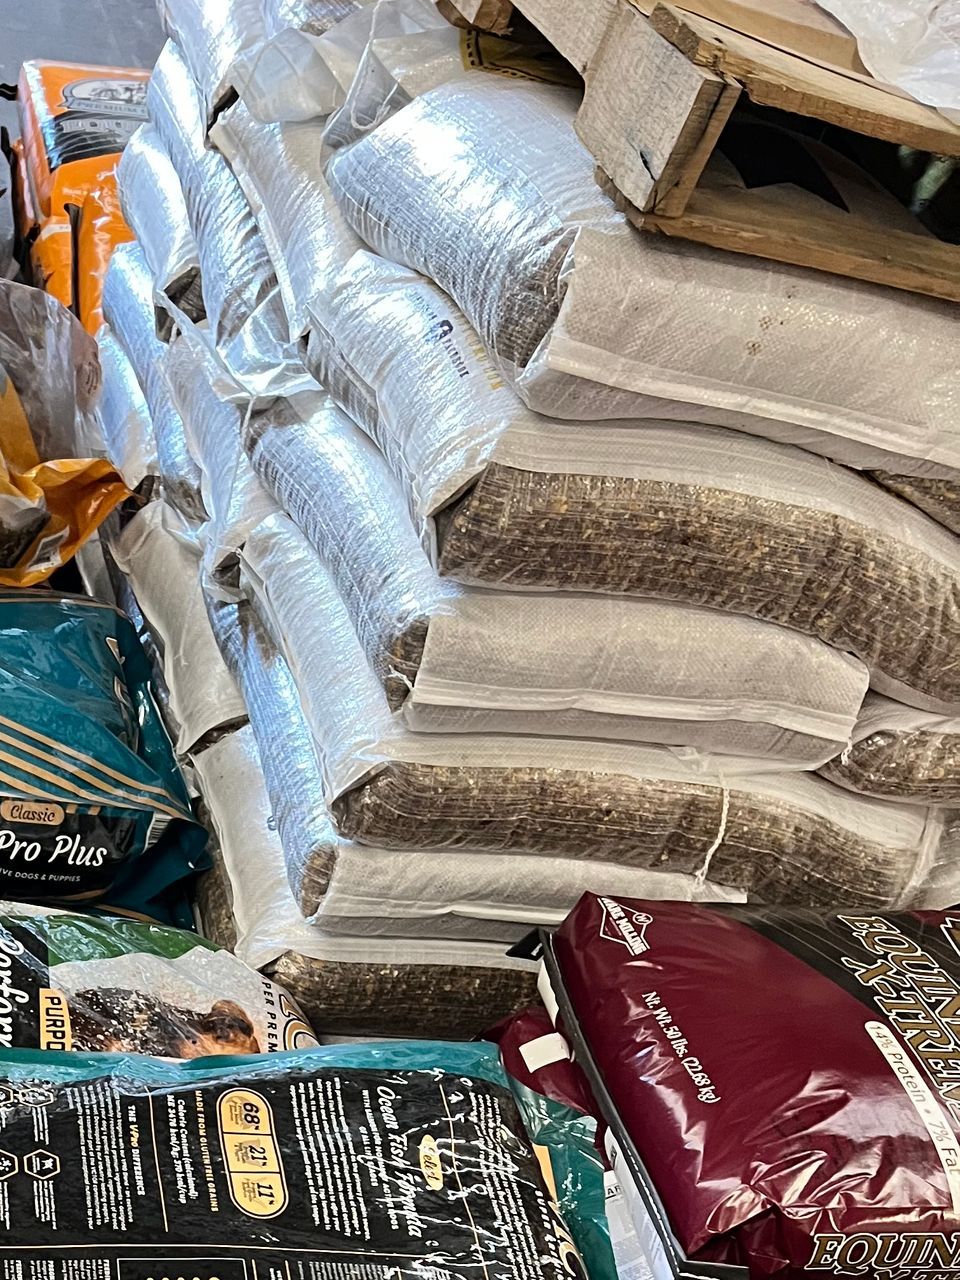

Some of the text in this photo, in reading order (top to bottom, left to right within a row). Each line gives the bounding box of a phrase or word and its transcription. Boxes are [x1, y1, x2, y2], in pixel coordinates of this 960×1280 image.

[10, 805, 56, 822] Classic
[48, 835, 108, 867] Plus
[15, 872, 39, 881] DOGS
[49, 874, 81, 883] PUPPIES
[618, 919, 648, 956] MILLING
[662, 1025, 680, 1043] 50
[869, 1024, 927, 1106] 14% Protein
[376, 1086, 399, 1130] Ocean
[128, 1105, 146, 1196] THE DIFFERENCE
[195, 1090, 219, 1212] MADE FROM GLUTEN GRAINS
